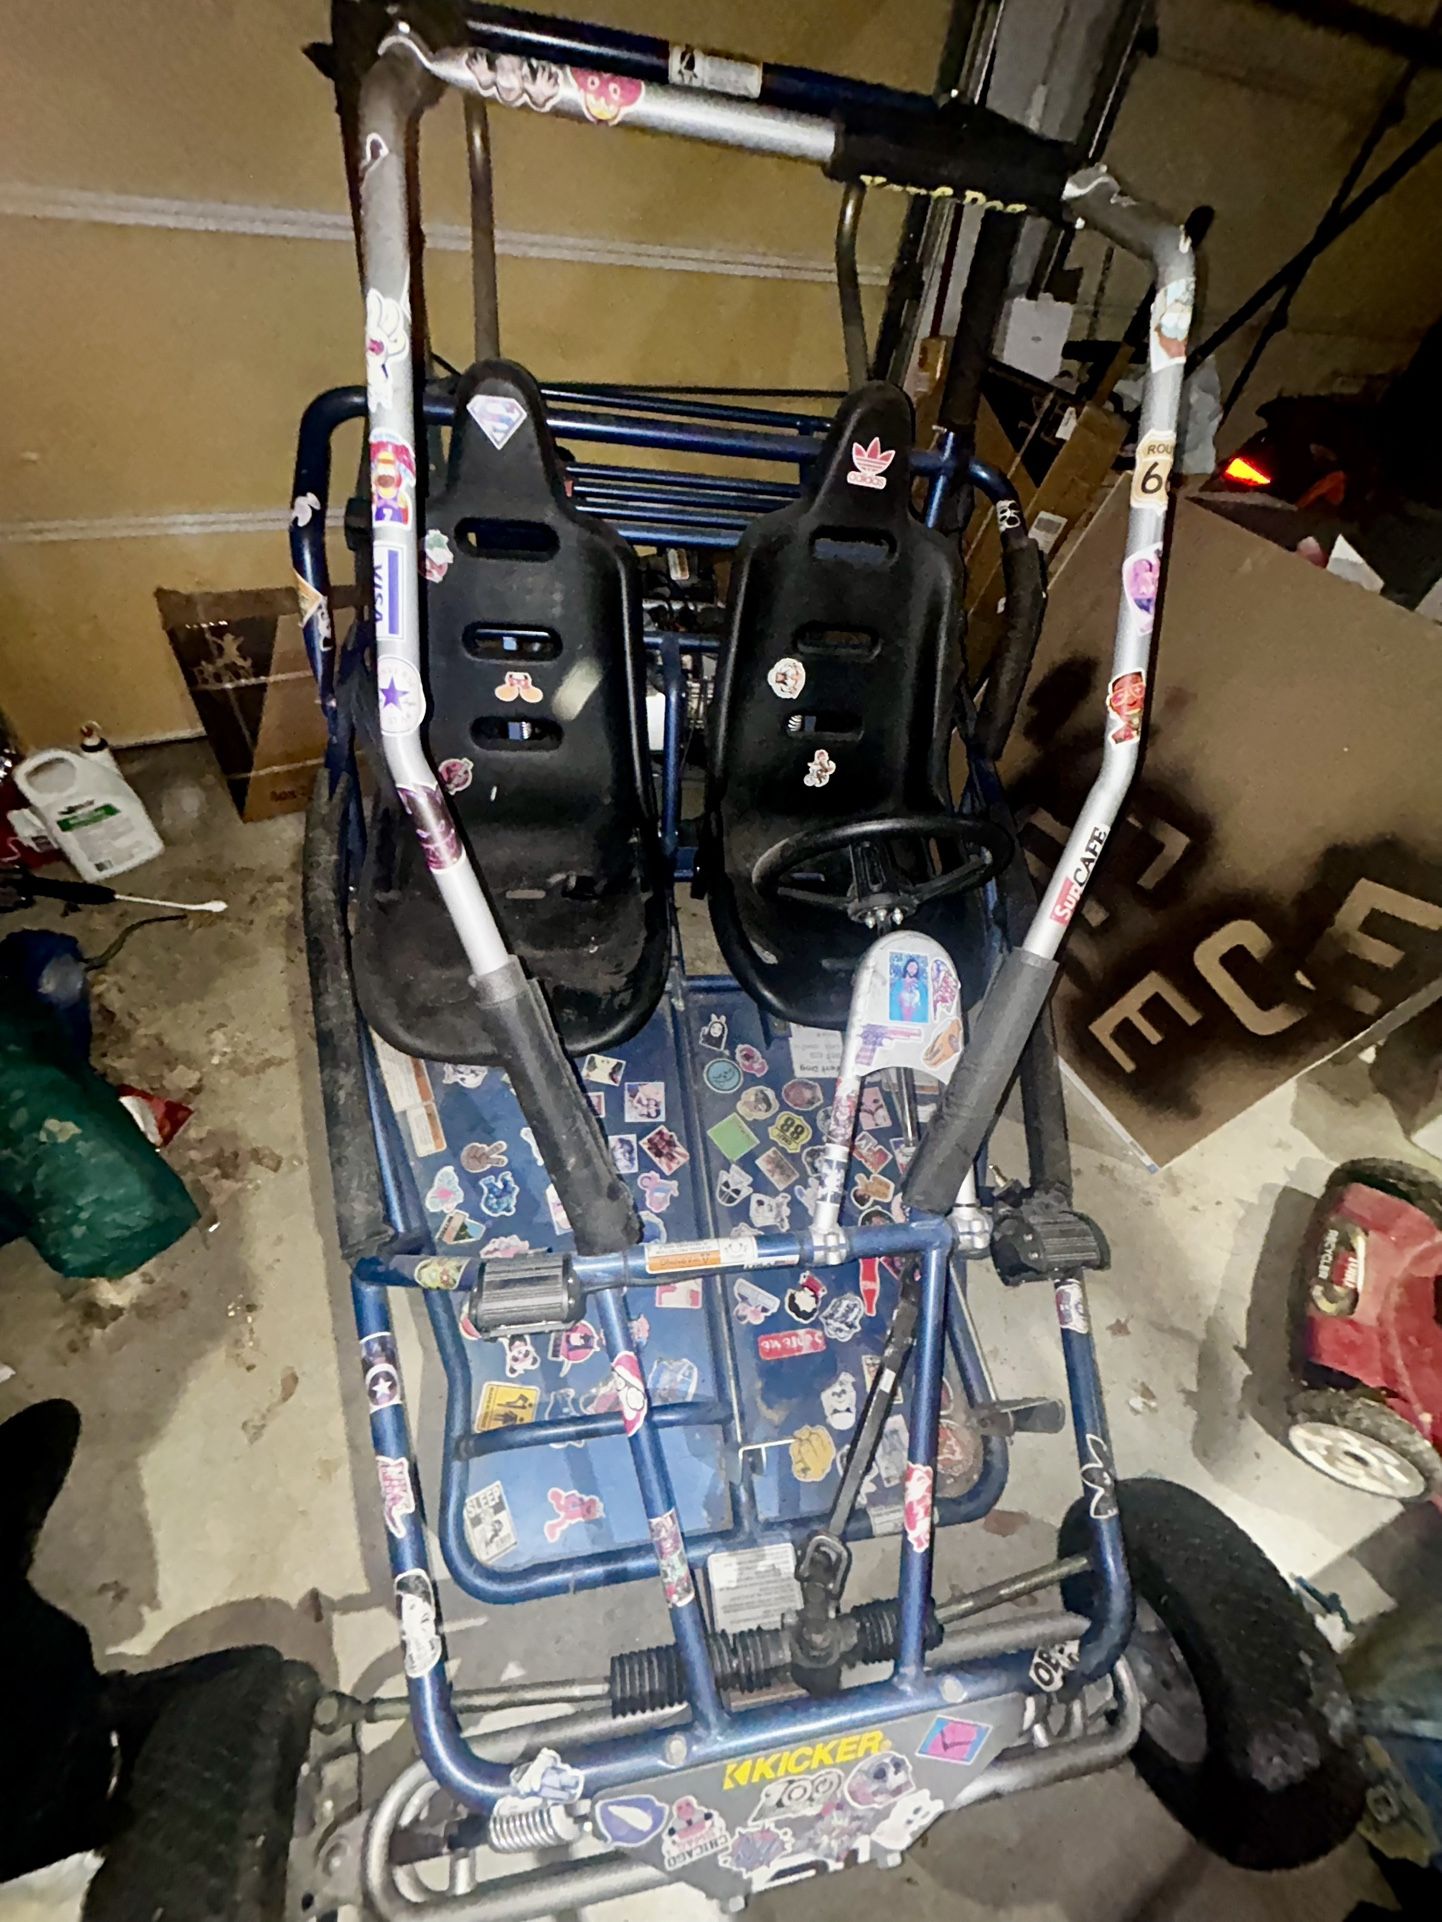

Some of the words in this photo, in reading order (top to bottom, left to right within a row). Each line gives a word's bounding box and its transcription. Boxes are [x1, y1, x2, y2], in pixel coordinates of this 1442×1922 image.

[1141, 461, 1171, 494] 6
[751, 1730, 884, 1783] KICKER
[667, 1834, 728, 1868] CHICAGO
